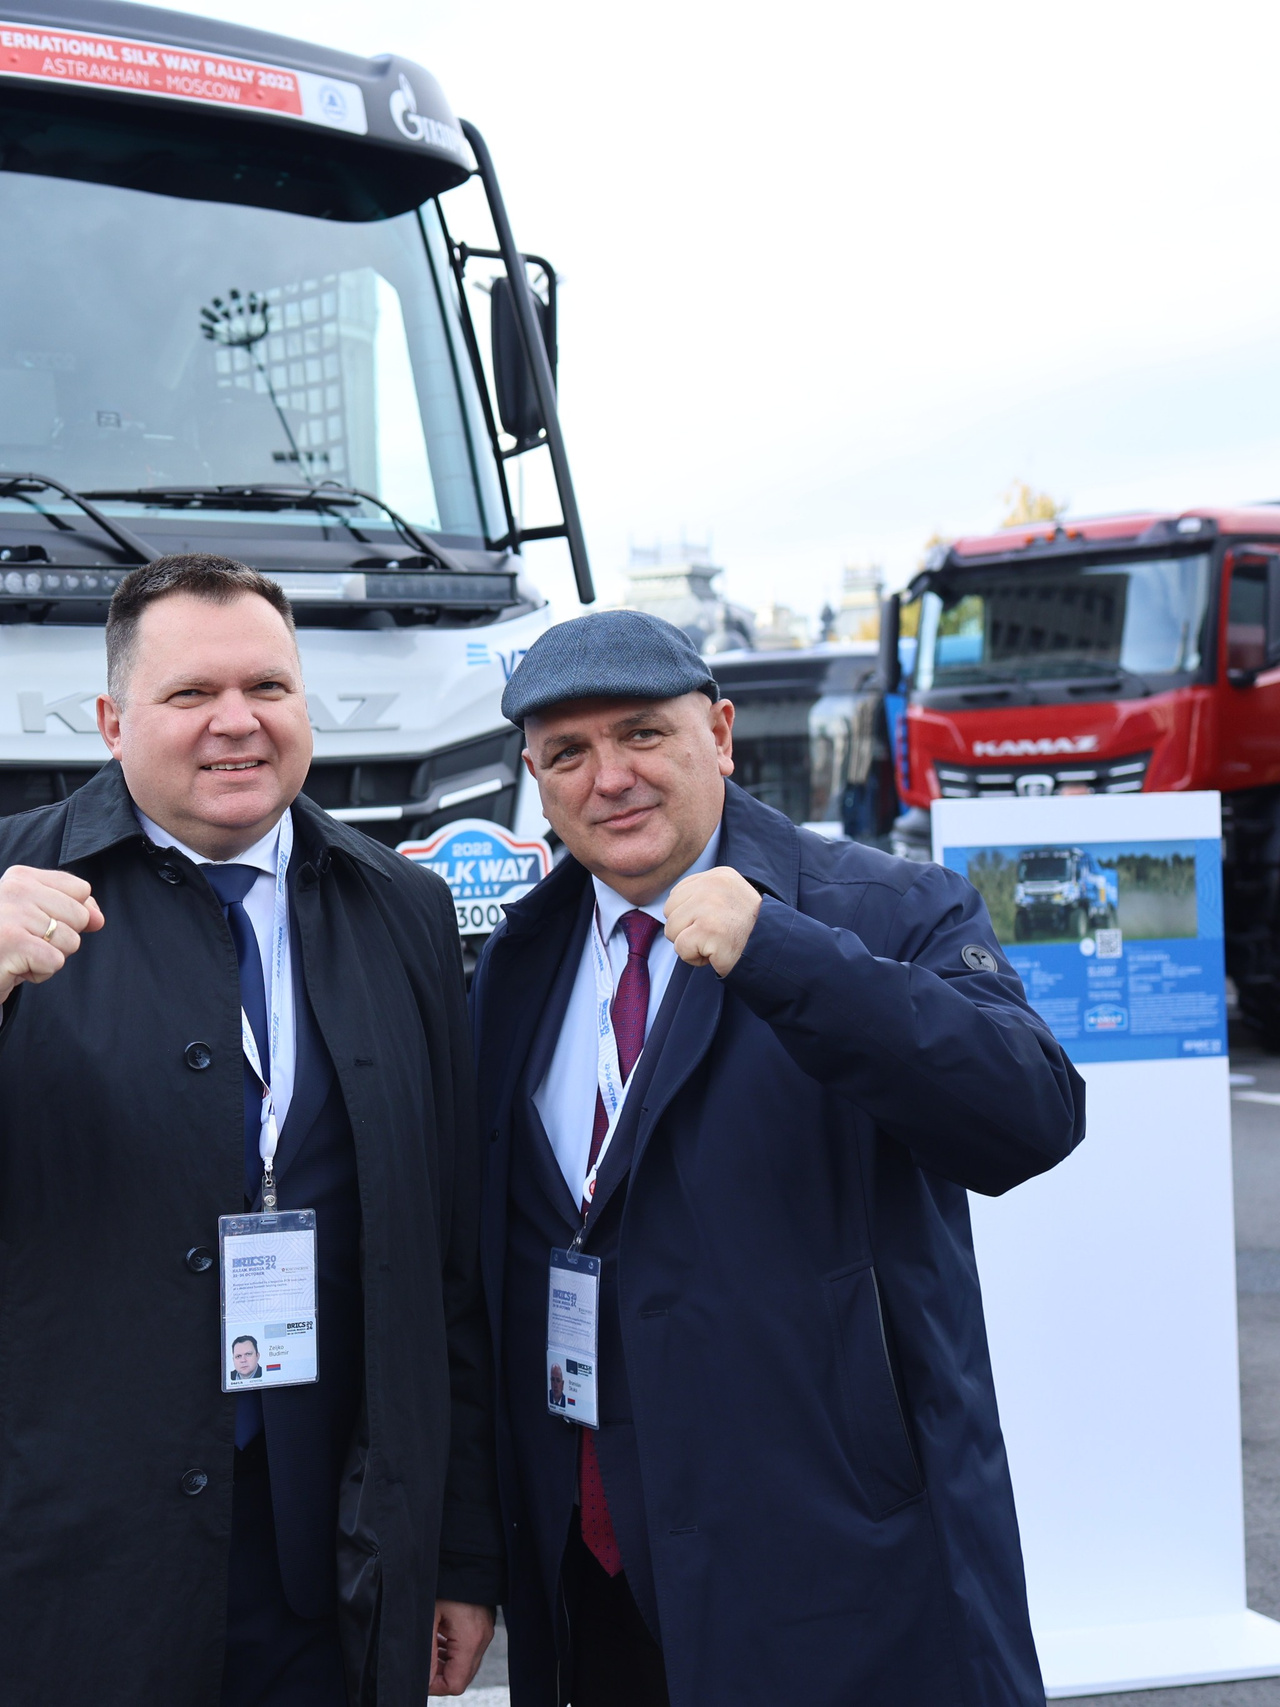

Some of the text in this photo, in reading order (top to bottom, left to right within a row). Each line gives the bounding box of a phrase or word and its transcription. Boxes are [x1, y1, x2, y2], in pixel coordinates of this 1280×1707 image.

[41, 57, 150, 86] ASTRAKHAN
[165, 73, 241, 101] MOSCOW
[120, 45, 160, 67] SILK
[162, 53, 203, 75] WAY
[204, 60, 254, 83] RALLY
[257, 70, 296, 91] 2022
[973, 734, 1099, 757] KAMAZ
[451, 842, 493, 857] 2022
[478, 856, 536, 884] WAY
[452, 884, 502, 897] RALLY
[457, 904, 500, 928] 300
[232, 1255, 276, 1268] BRICS 20
[286, 1321, 306, 1330] BRICS
